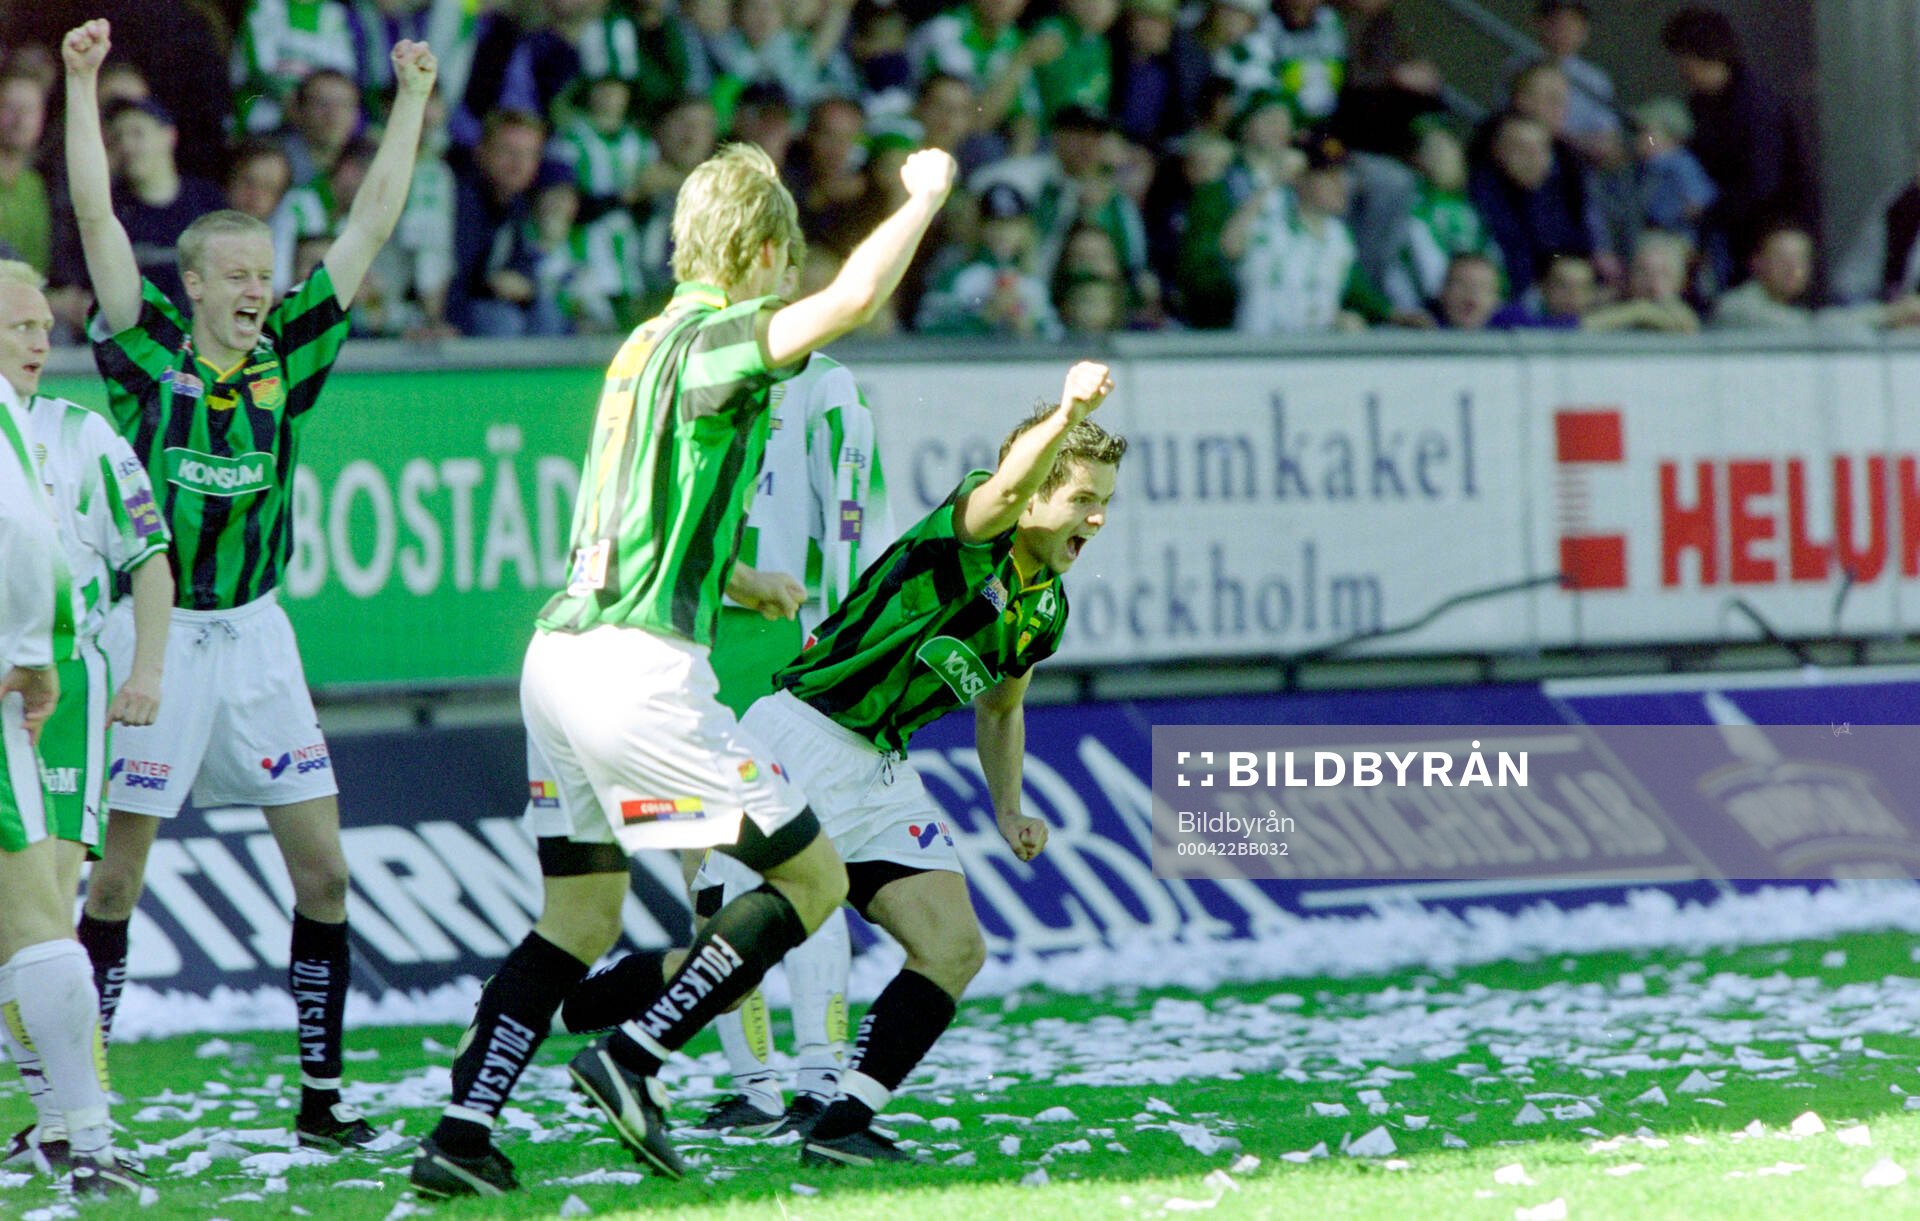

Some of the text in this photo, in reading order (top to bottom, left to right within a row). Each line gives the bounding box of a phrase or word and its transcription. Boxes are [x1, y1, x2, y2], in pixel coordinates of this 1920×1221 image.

[178, 458, 264, 489] KONSUM
[912, 386, 1478, 509] ceumkakel
[1064, 538, 1386, 643] ockholm
[126, 773, 167, 791] SPORT
[127, 759, 170, 777] INTER
[292, 958, 331, 1063] OLKSAM
[637, 934, 744, 1039] FOLKSAM
